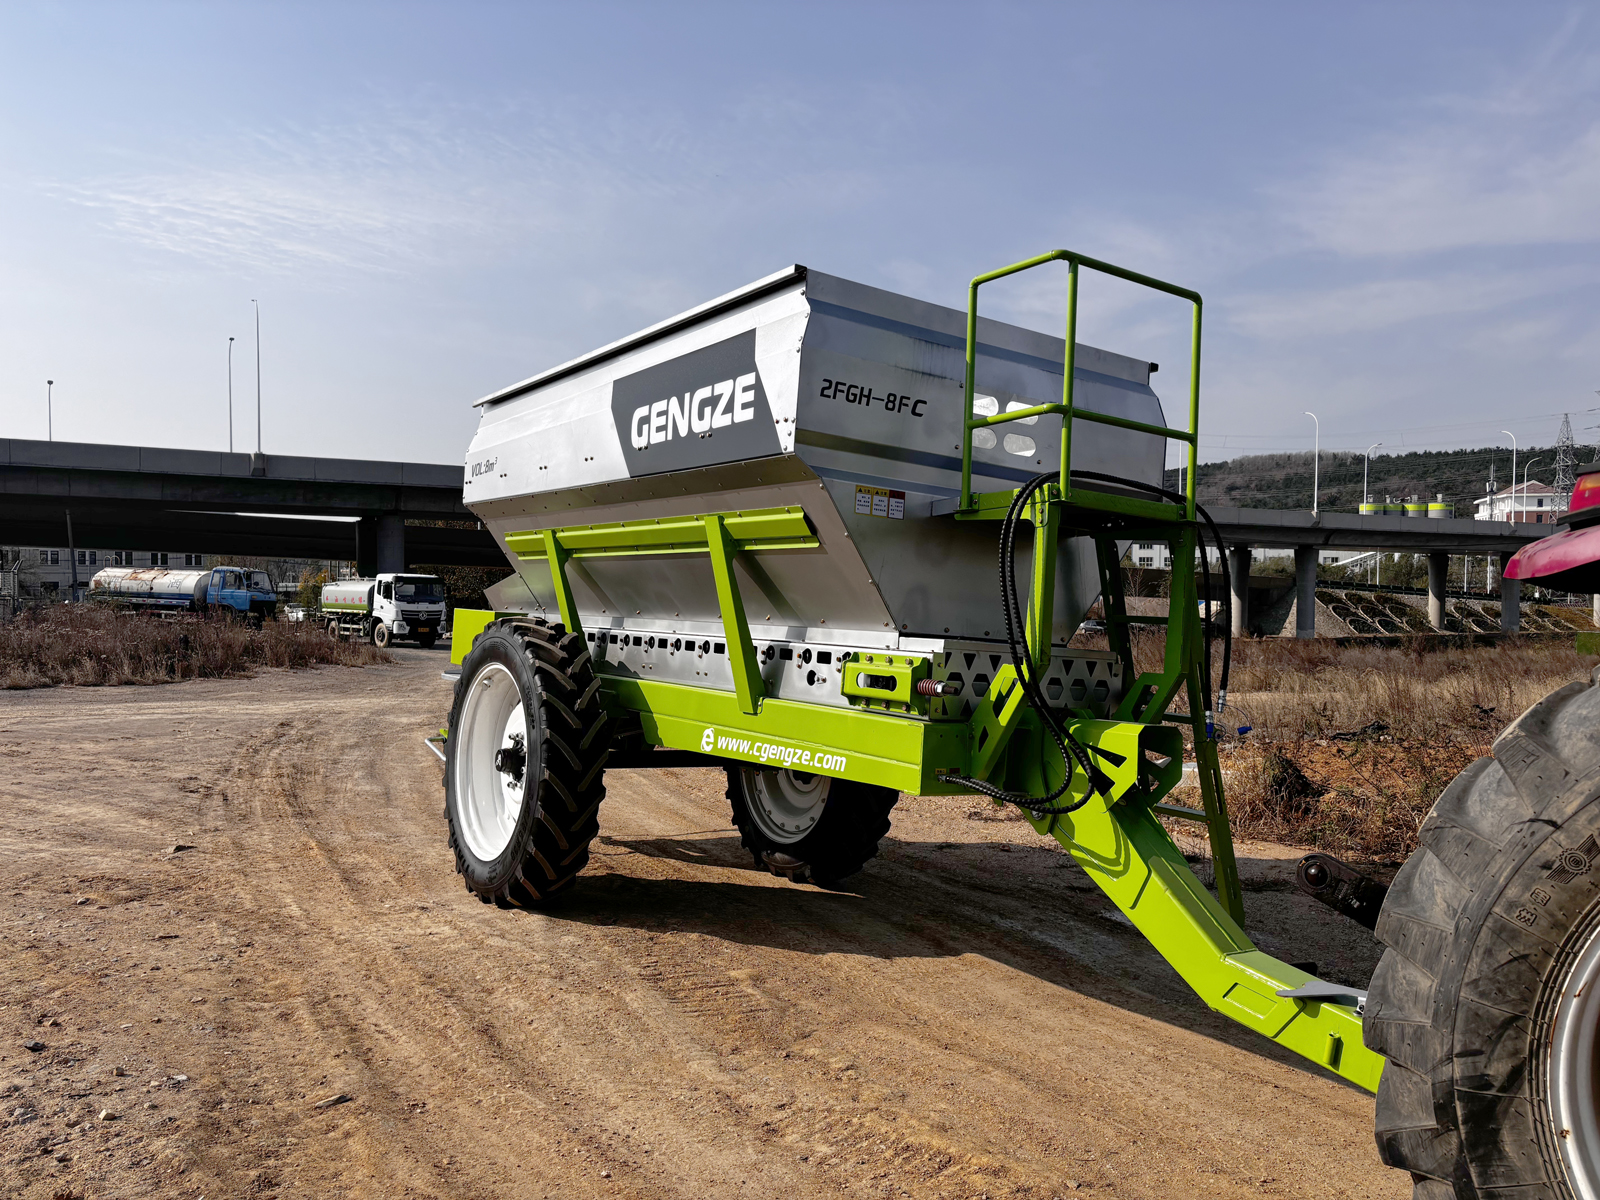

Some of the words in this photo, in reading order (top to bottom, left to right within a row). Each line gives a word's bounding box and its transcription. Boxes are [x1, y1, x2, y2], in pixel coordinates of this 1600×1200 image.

[631, 372, 756, 449] GENGZE
[820, 378, 928, 417] 2FGH-8FC
[717, 735, 847, 772] www.cgengze.com
